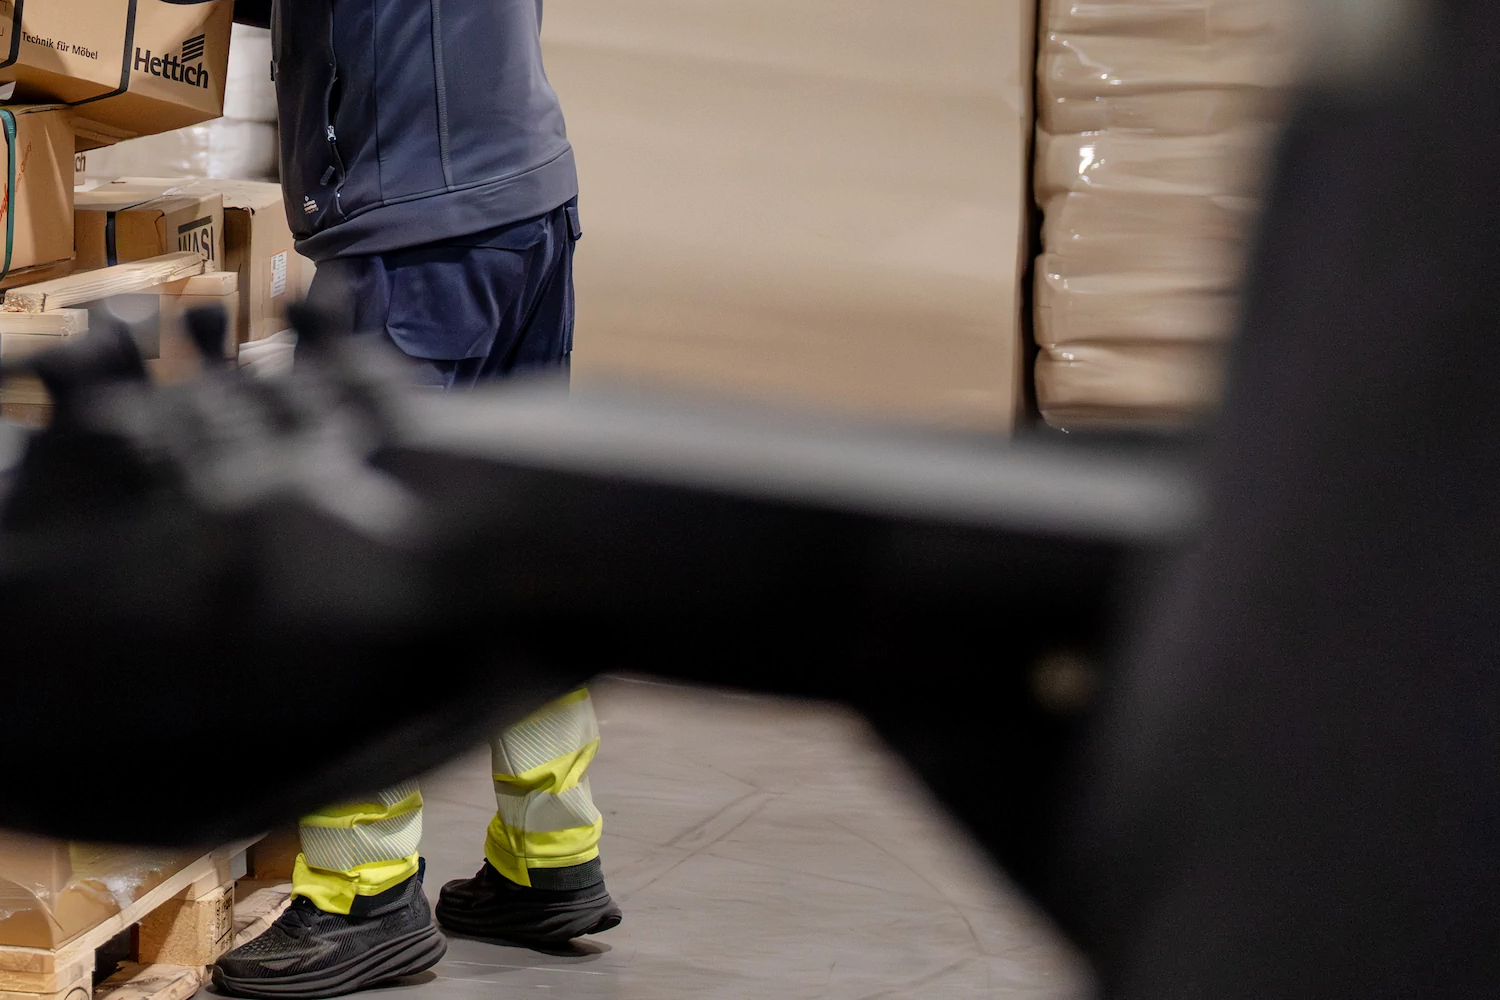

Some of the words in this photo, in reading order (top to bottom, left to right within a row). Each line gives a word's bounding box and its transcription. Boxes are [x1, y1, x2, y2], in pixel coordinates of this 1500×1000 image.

[22, 32, 54, 48] Technik
[56, 40, 70, 53] für
[71, 44, 98, 60] Möbel
[133, 47, 209, 89] Hettich
